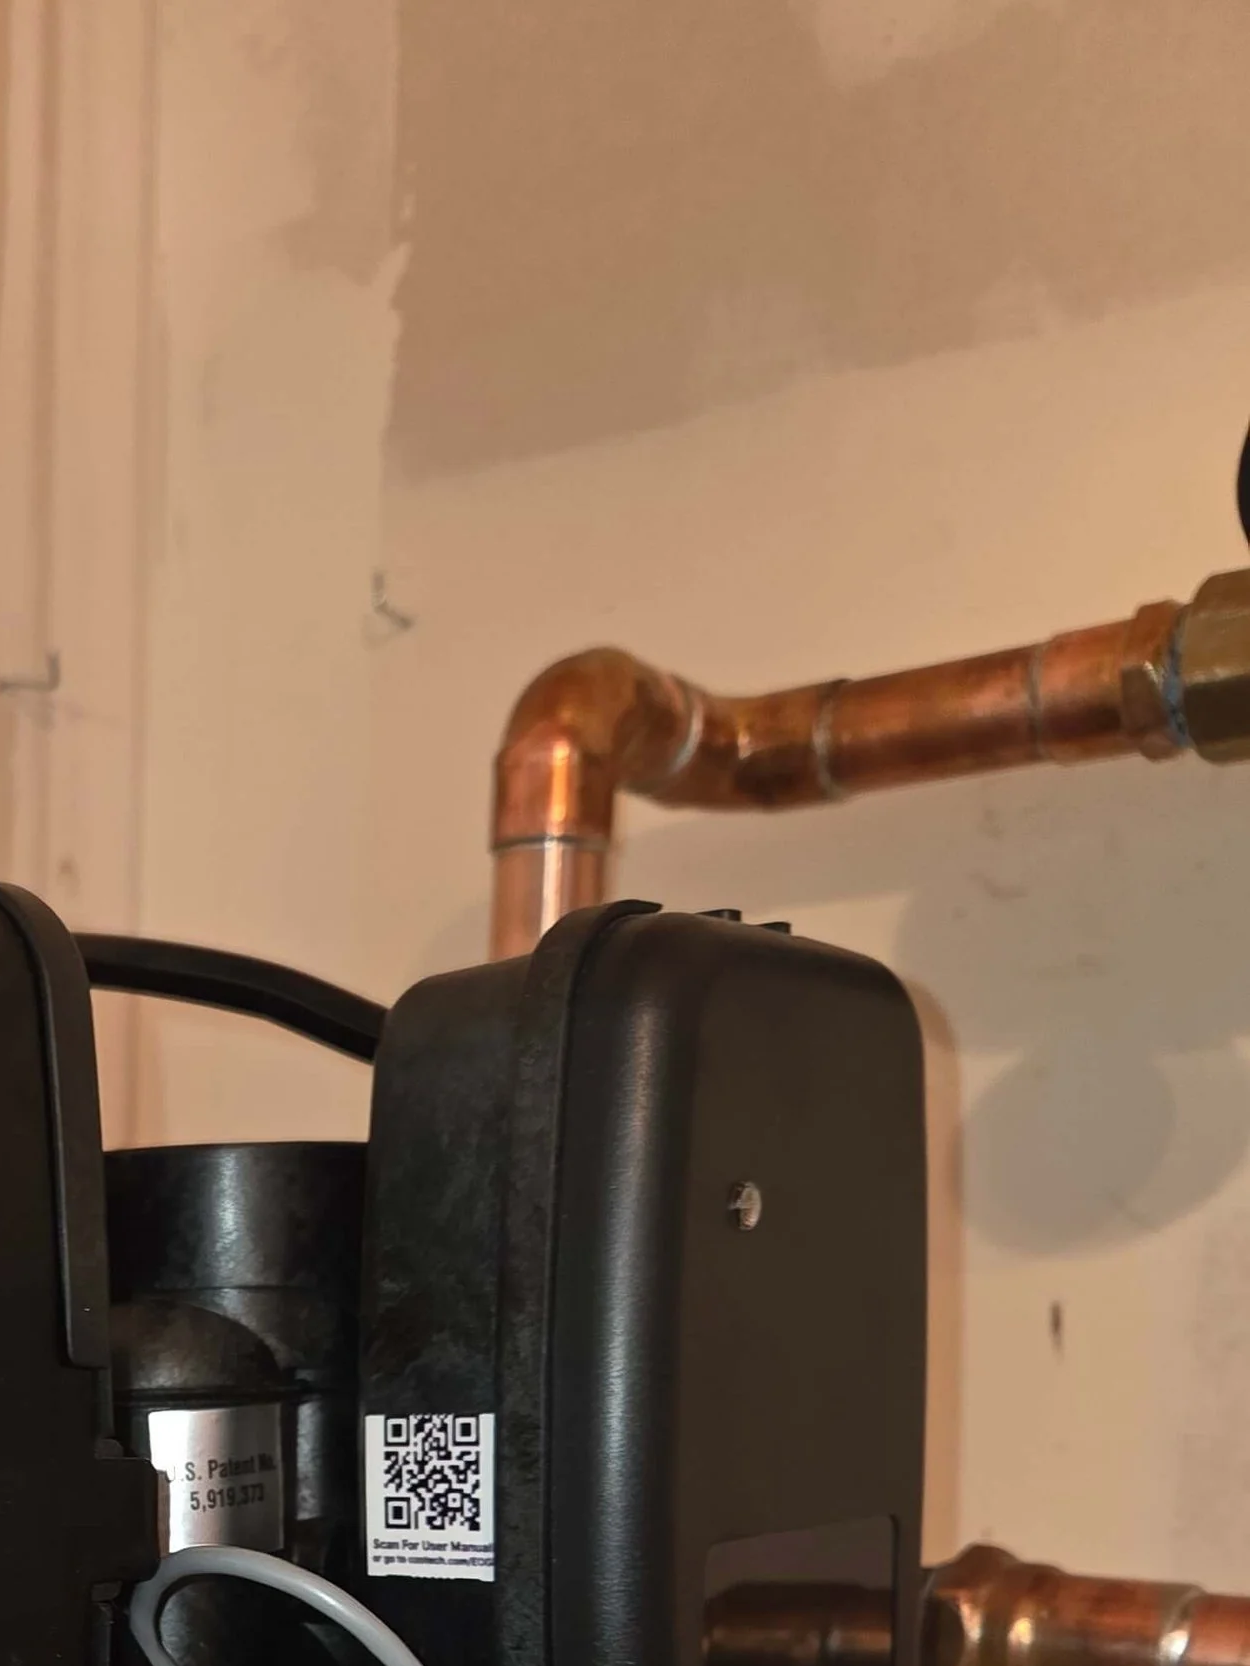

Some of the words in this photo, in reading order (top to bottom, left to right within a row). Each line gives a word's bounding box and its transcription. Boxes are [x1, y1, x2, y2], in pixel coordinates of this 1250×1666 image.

[207, 1455, 256, 1480] Patent
[373, 1538, 400, 1550] Scan
[402, 1539, 420, 1552] For
[422, 1540, 448, 1552] User
[450, 1541, 494, 1553] Manual
